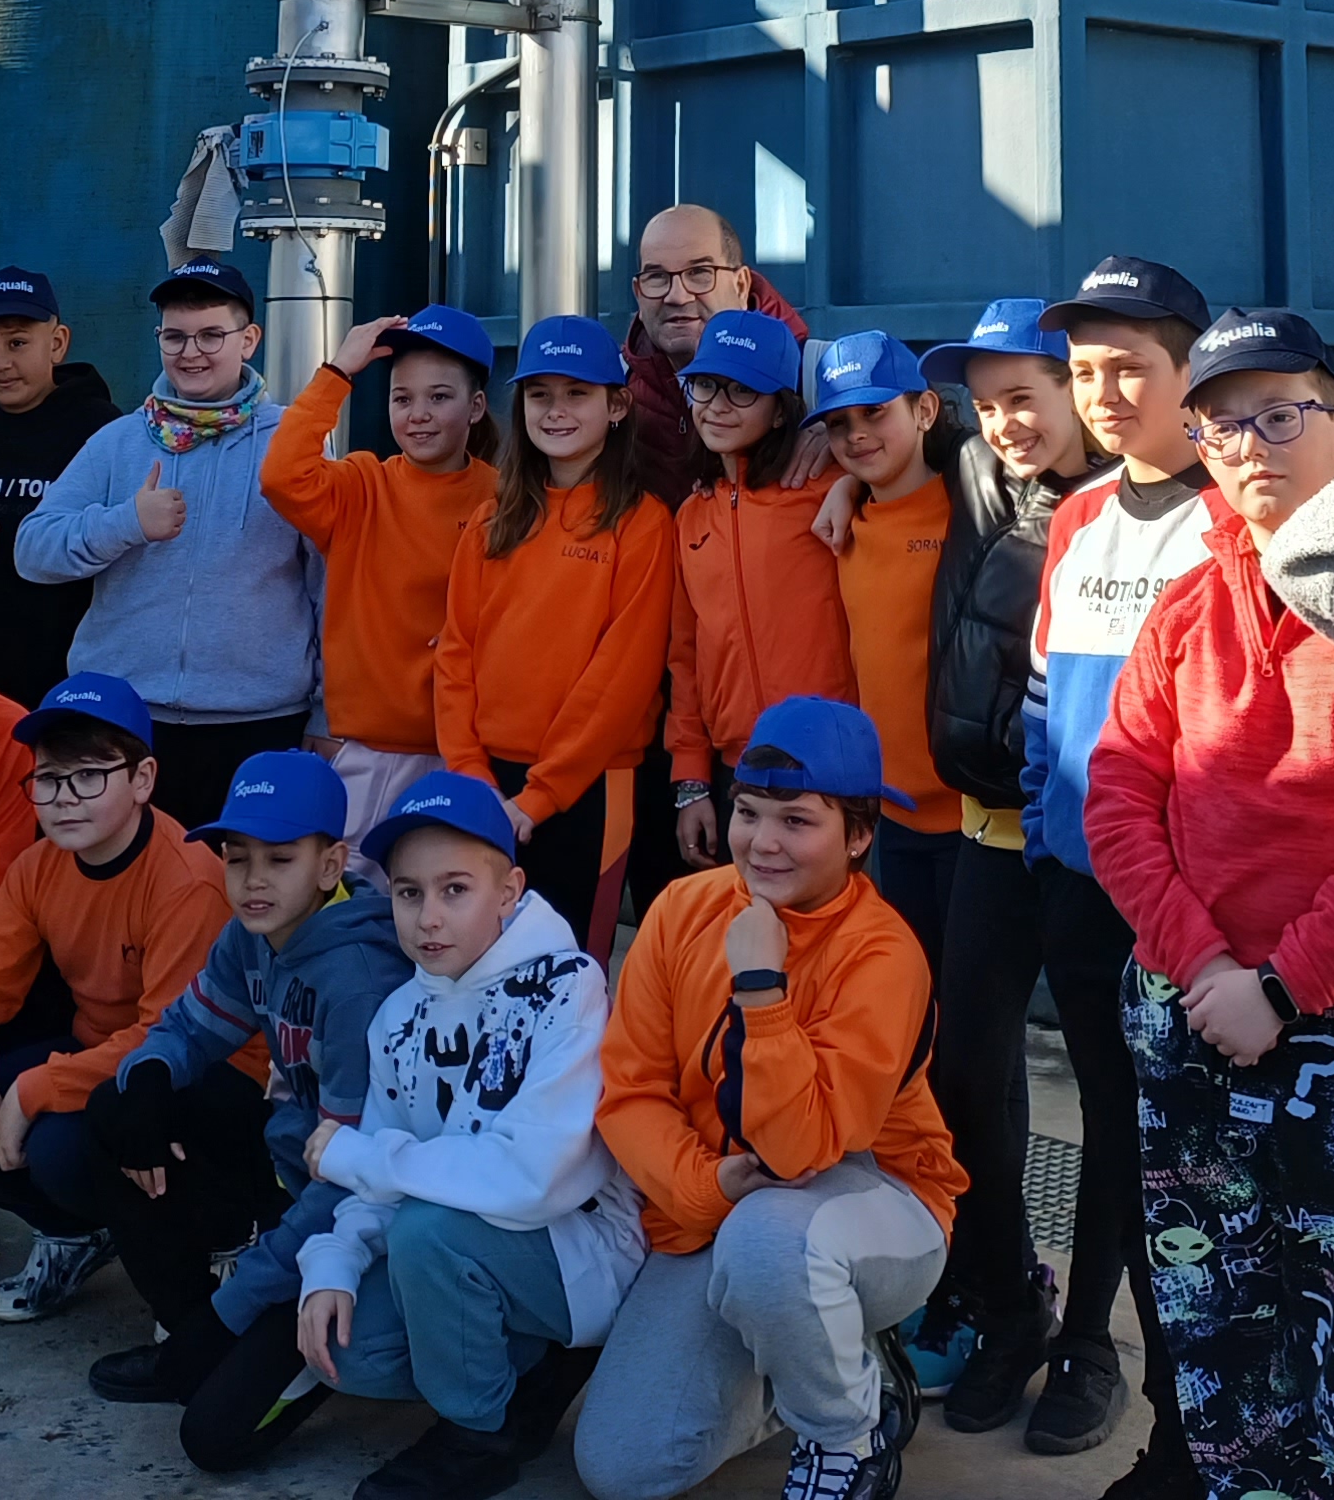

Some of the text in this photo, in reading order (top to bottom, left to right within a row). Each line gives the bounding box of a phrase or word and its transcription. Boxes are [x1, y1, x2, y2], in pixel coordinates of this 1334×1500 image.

[544, 343, 583, 356] aqualia
[718, 335, 756, 351] aqualia
[60, 690, 102, 704] aqualia
[234, 780, 275, 798] aqualia
[405, 794, 452, 814] aqualia
